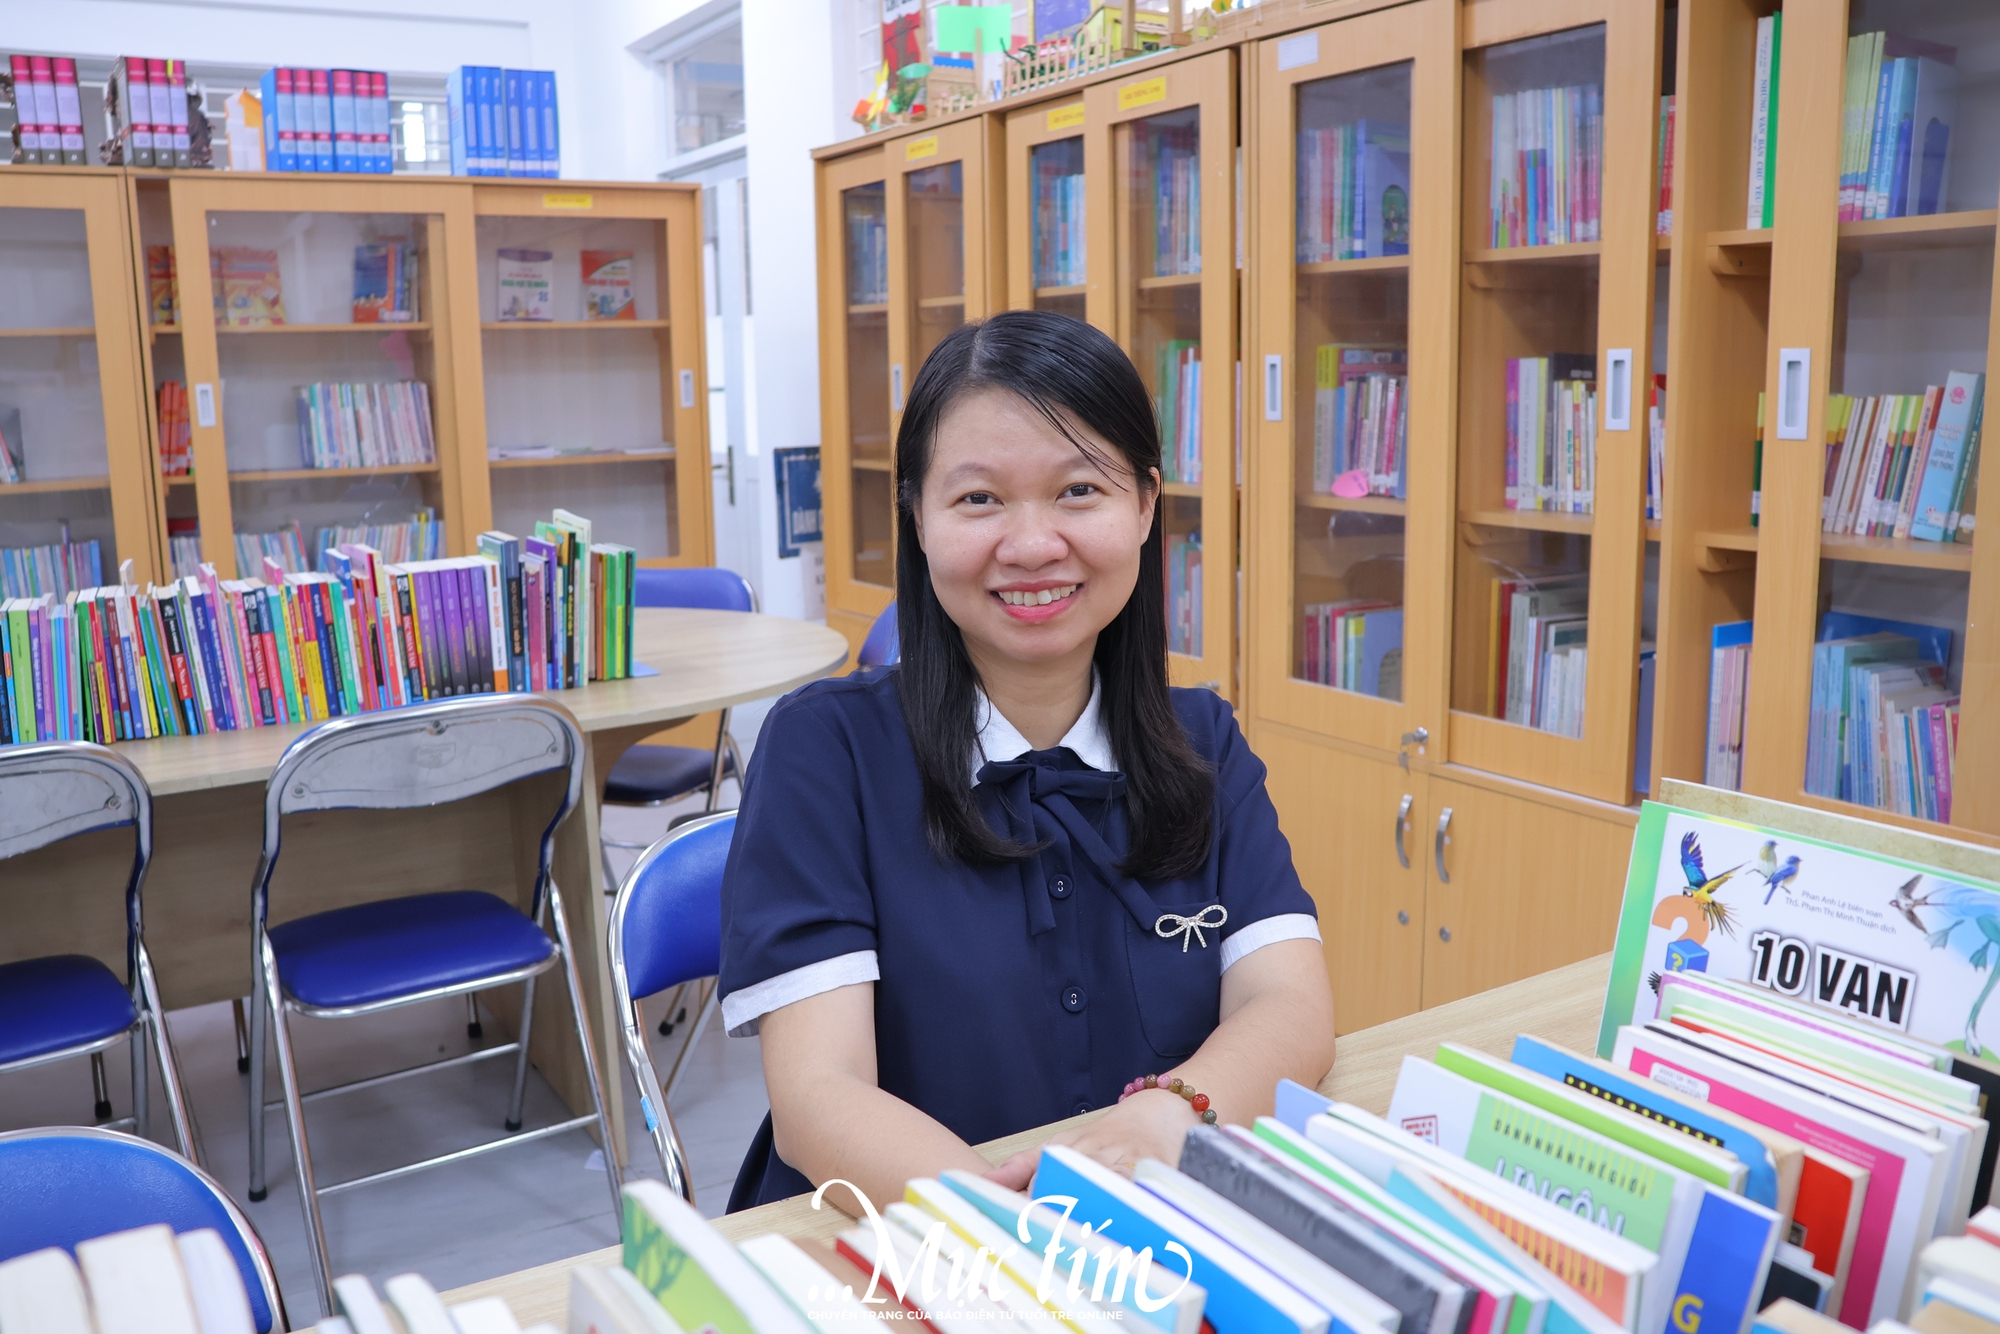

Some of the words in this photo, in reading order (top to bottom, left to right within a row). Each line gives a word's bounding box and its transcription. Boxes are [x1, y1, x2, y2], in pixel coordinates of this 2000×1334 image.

[1801, 890, 1820, 901] Phan
[1821, 896, 1836, 906] Anh
[1848, 902, 1864, 913] biên
[1836, 911, 1854, 922] Minh
[1756, 935, 1806, 991] 10
[1671, 1292, 1704, 1334] G
